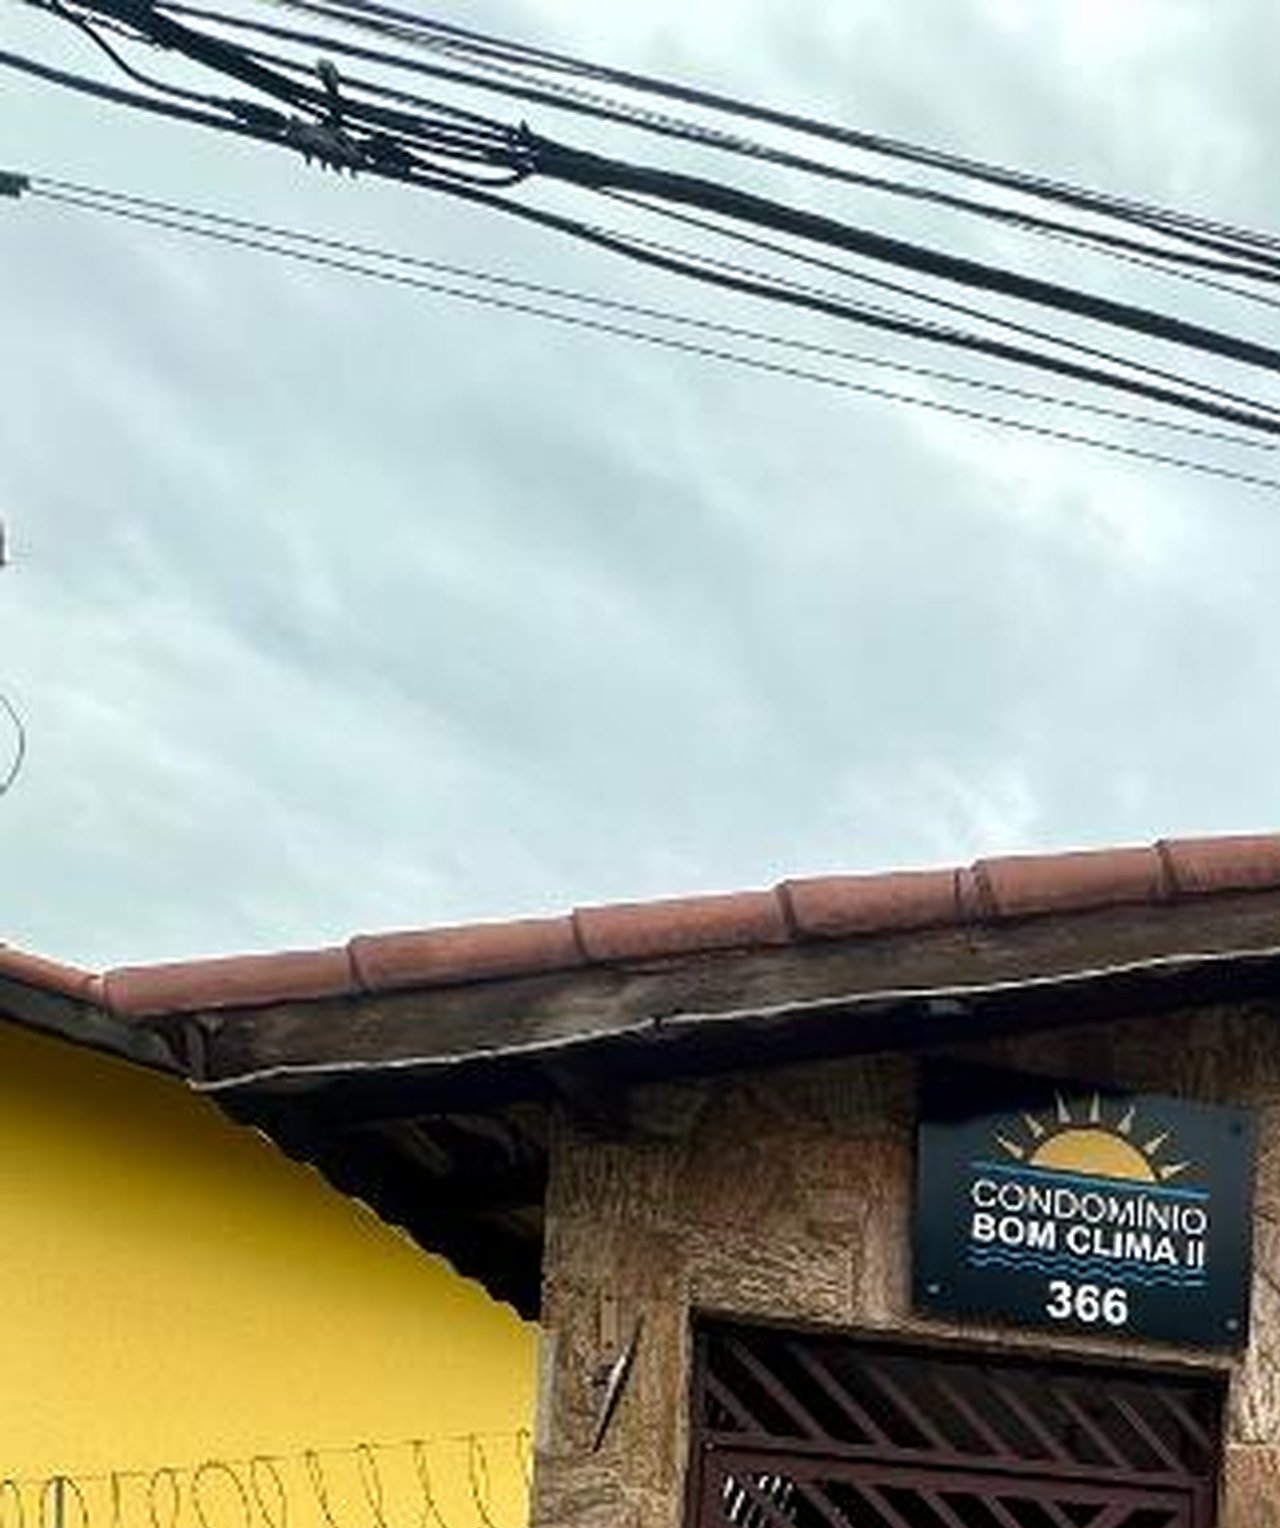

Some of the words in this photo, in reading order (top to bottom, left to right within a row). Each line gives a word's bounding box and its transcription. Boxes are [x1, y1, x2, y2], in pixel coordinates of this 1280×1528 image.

[971, 1179, 1208, 1235] CONDOMÍNIO
[971, 1212, 1056, 1250] BOM
[1066, 1225, 1178, 1265] CLIMA
[1187, 1241, 1204, 1267] II
[1046, 1281, 1128, 1325] 366
